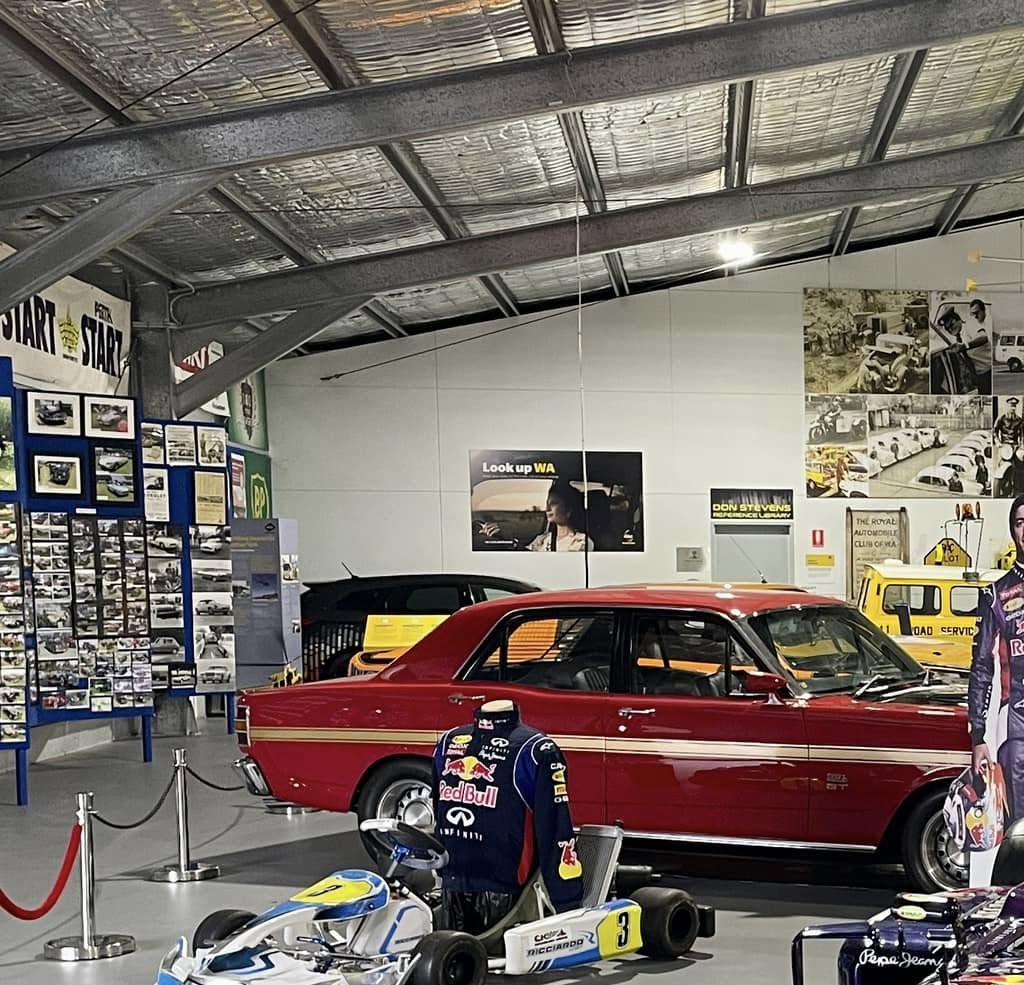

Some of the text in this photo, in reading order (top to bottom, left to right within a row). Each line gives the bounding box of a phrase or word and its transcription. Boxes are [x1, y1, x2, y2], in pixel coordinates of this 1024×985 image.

[2, 294, 56, 355] START
[81, 314, 123, 378] START
[482, 462, 556, 475] Look up WA
[713, 504, 791, 512] DON STEVENS
[856, 517, 897, 526] THE ROYAL
[854, 529, 898, 537] AUTOMOBILE
[854, 540, 873, 548] CLUB
[912, 626, 976, 636] OAD SERVIC
[439, 780, 499, 809] Red Bull
[439, 828, 484, 841] INFINITI
[615, 910, 630, 951] 3
[527, 938, 584, 956] RICCIARDO
[858, 948, 899, 968] Pepe
